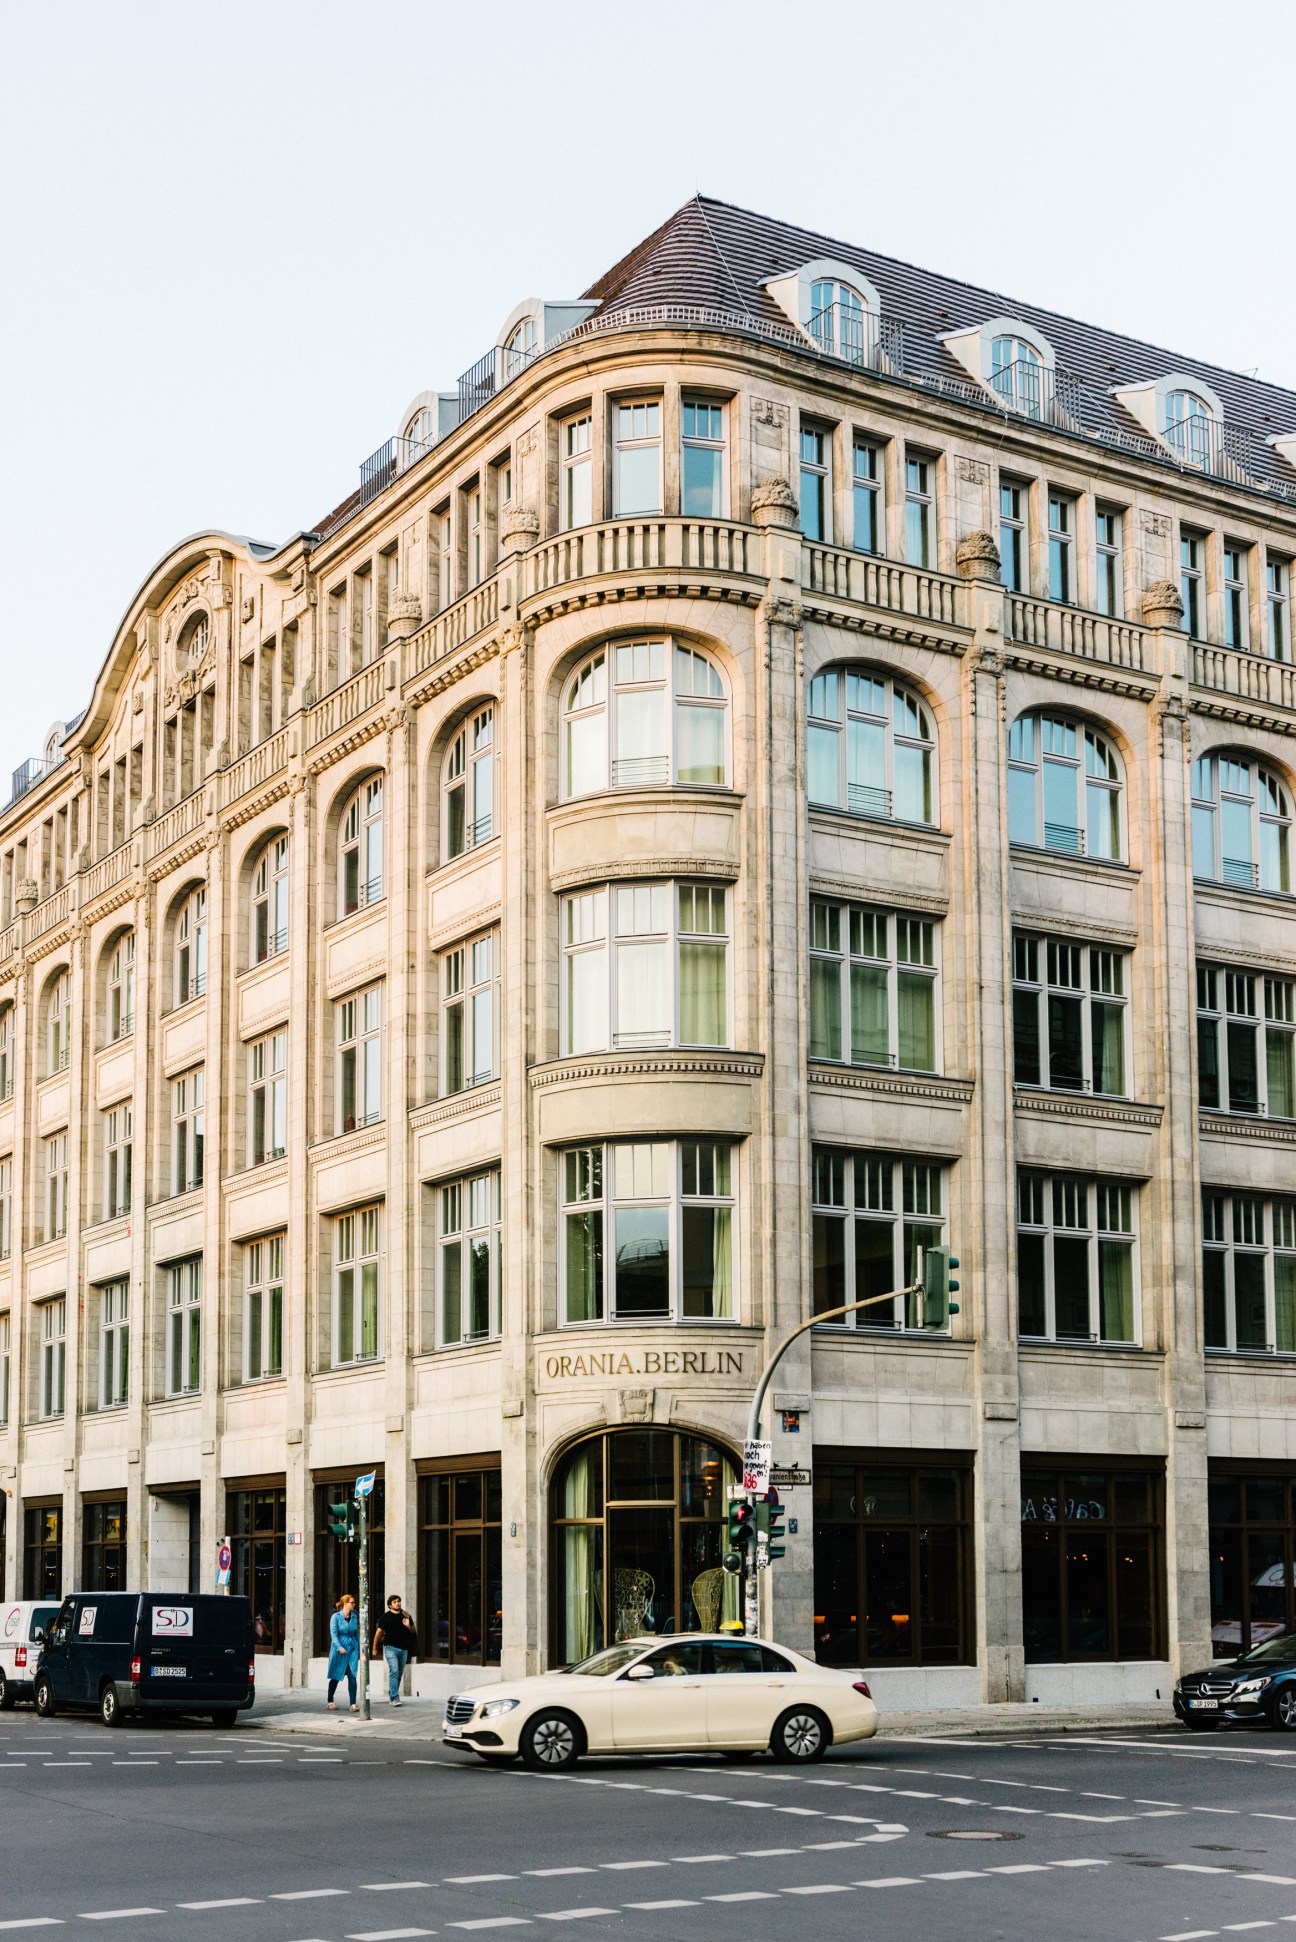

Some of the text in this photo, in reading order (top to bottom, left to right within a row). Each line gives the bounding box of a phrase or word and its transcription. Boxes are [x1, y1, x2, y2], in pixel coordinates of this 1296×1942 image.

[546, 1352, 744, 1378] ORANIA.BERLIN
[750, 1441, 771, 1450] haben
[156, 1609, 190, 1627] SD
